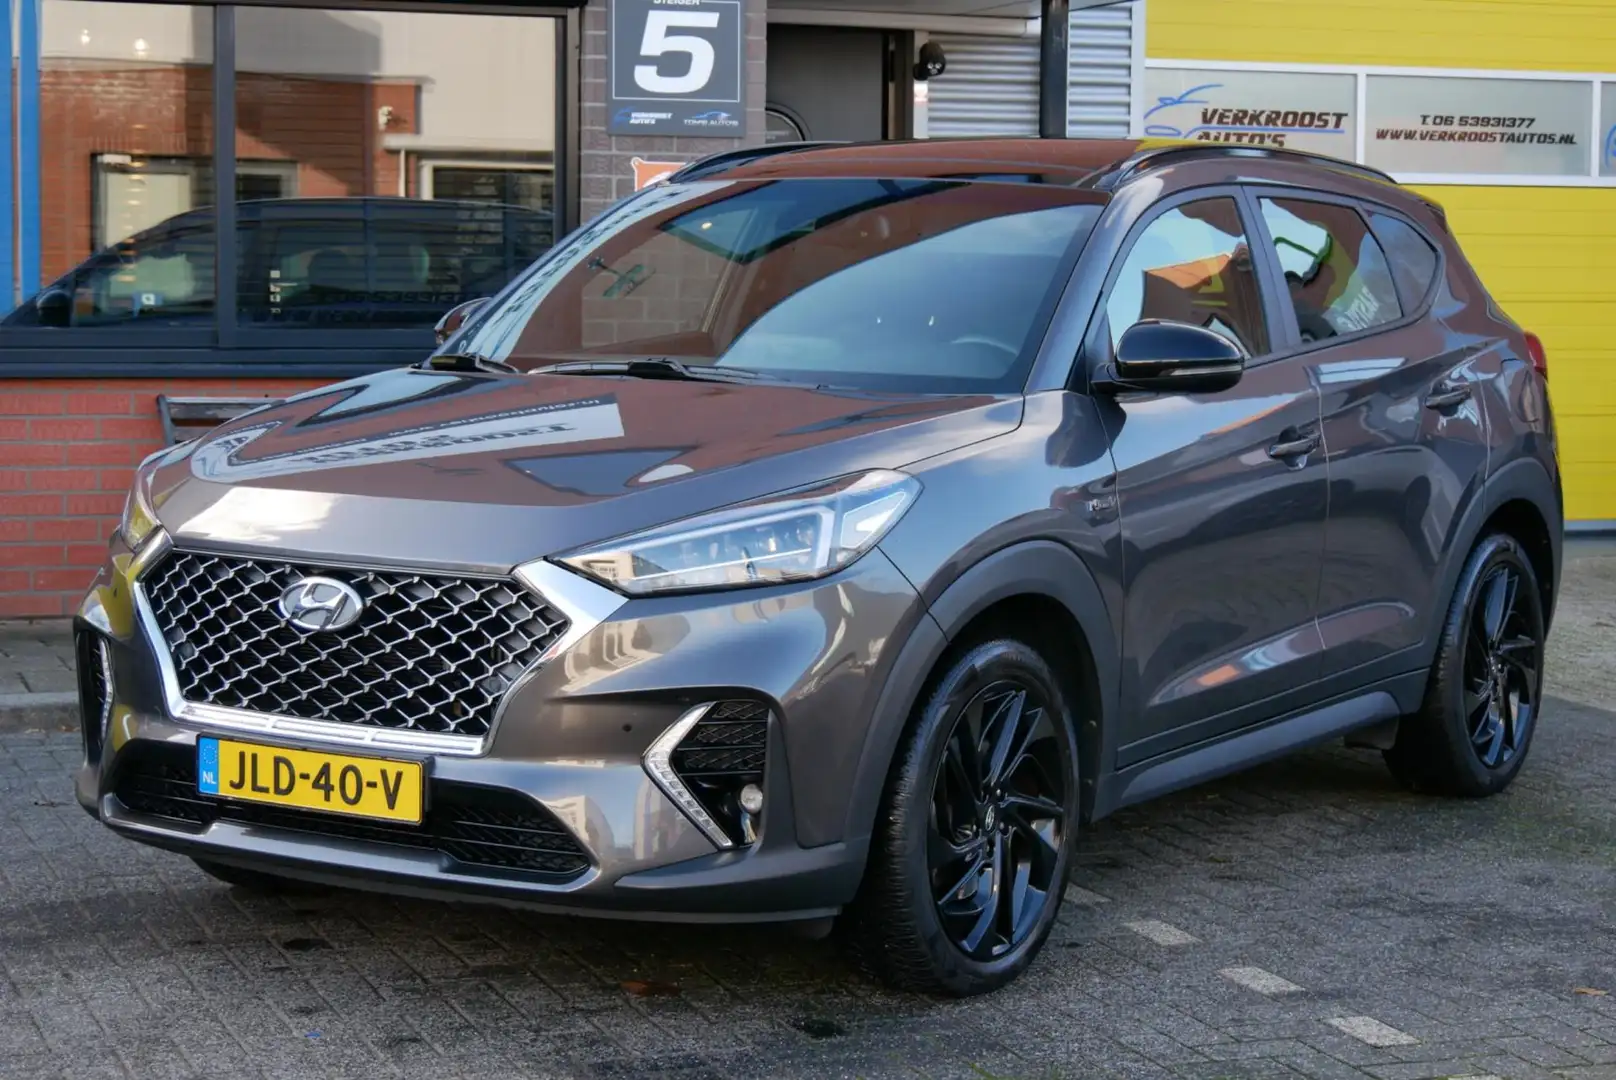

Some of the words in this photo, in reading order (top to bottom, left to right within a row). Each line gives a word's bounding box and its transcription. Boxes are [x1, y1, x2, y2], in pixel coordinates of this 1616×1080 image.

[633, 10, 720, 93] 5
[1200, 108, 1348, 129] VERKROOST
[1432, 115, 1454, 126] 06
[1458, 116, 1535, 128] 53931377
[1376, 128, 1577, 144] WWW.VERKROOSTAUTOS.NL
[202, 770, 217, 785] NL
[229, 751, 403, 810] JLD-40-V
